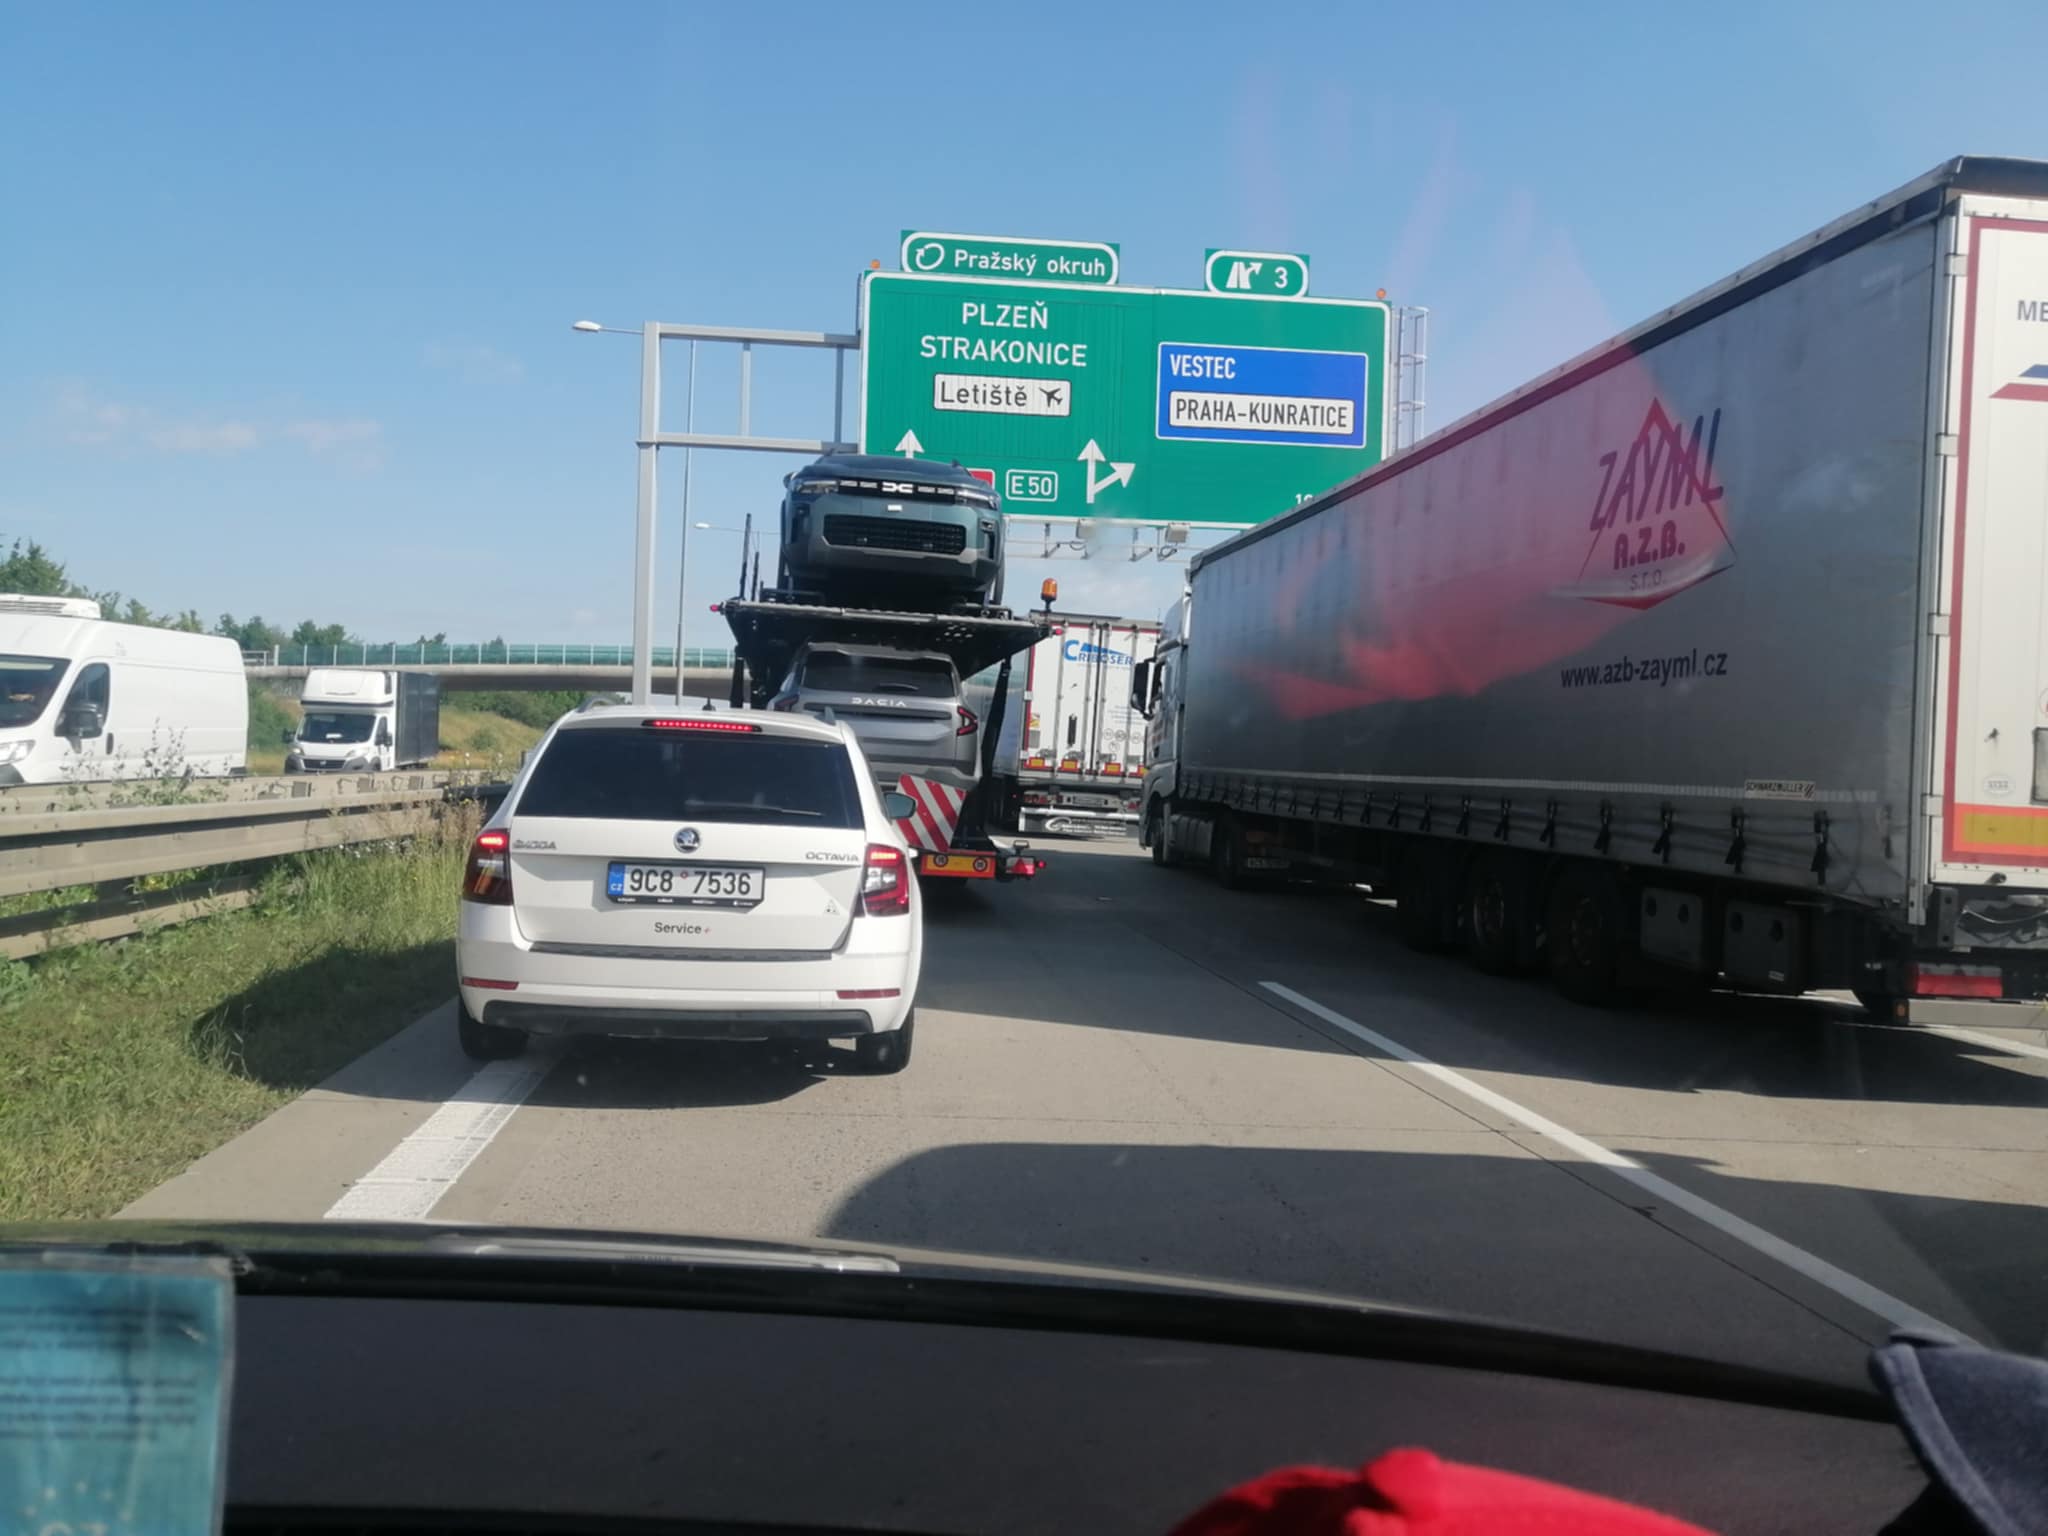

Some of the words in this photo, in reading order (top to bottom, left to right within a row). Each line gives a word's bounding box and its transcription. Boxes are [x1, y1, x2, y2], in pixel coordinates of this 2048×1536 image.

[954, 249, 1037, 276] Pražský
[1047, 256, 1106, 277] okruh
[1274, 266, 1288, 289] 3
[962, 301, 1049, 329] PLZEŇ
[920, 335, 1088, 367] STRAKONICE
[1169, 354, 1236, 379] VESTEC
[940, 381, 1028, 407] Letiště
[1175, 398, 1348, 428] PRAHA-KUNRATICE
[1590, 407, 1724, 531] ZAYML
[1011, 475, 1025, 495] E
[1028, 476, 1052, 496] 50
[1561, 648, 1728, 688] www.azb-zayml.cz
[851, 696, 907, 707] DACIA
[805, 851, 859, 862] OCTAVIA
[629, 868, 674, 893] 9C8
[693, 870, 752, 896] 7536
